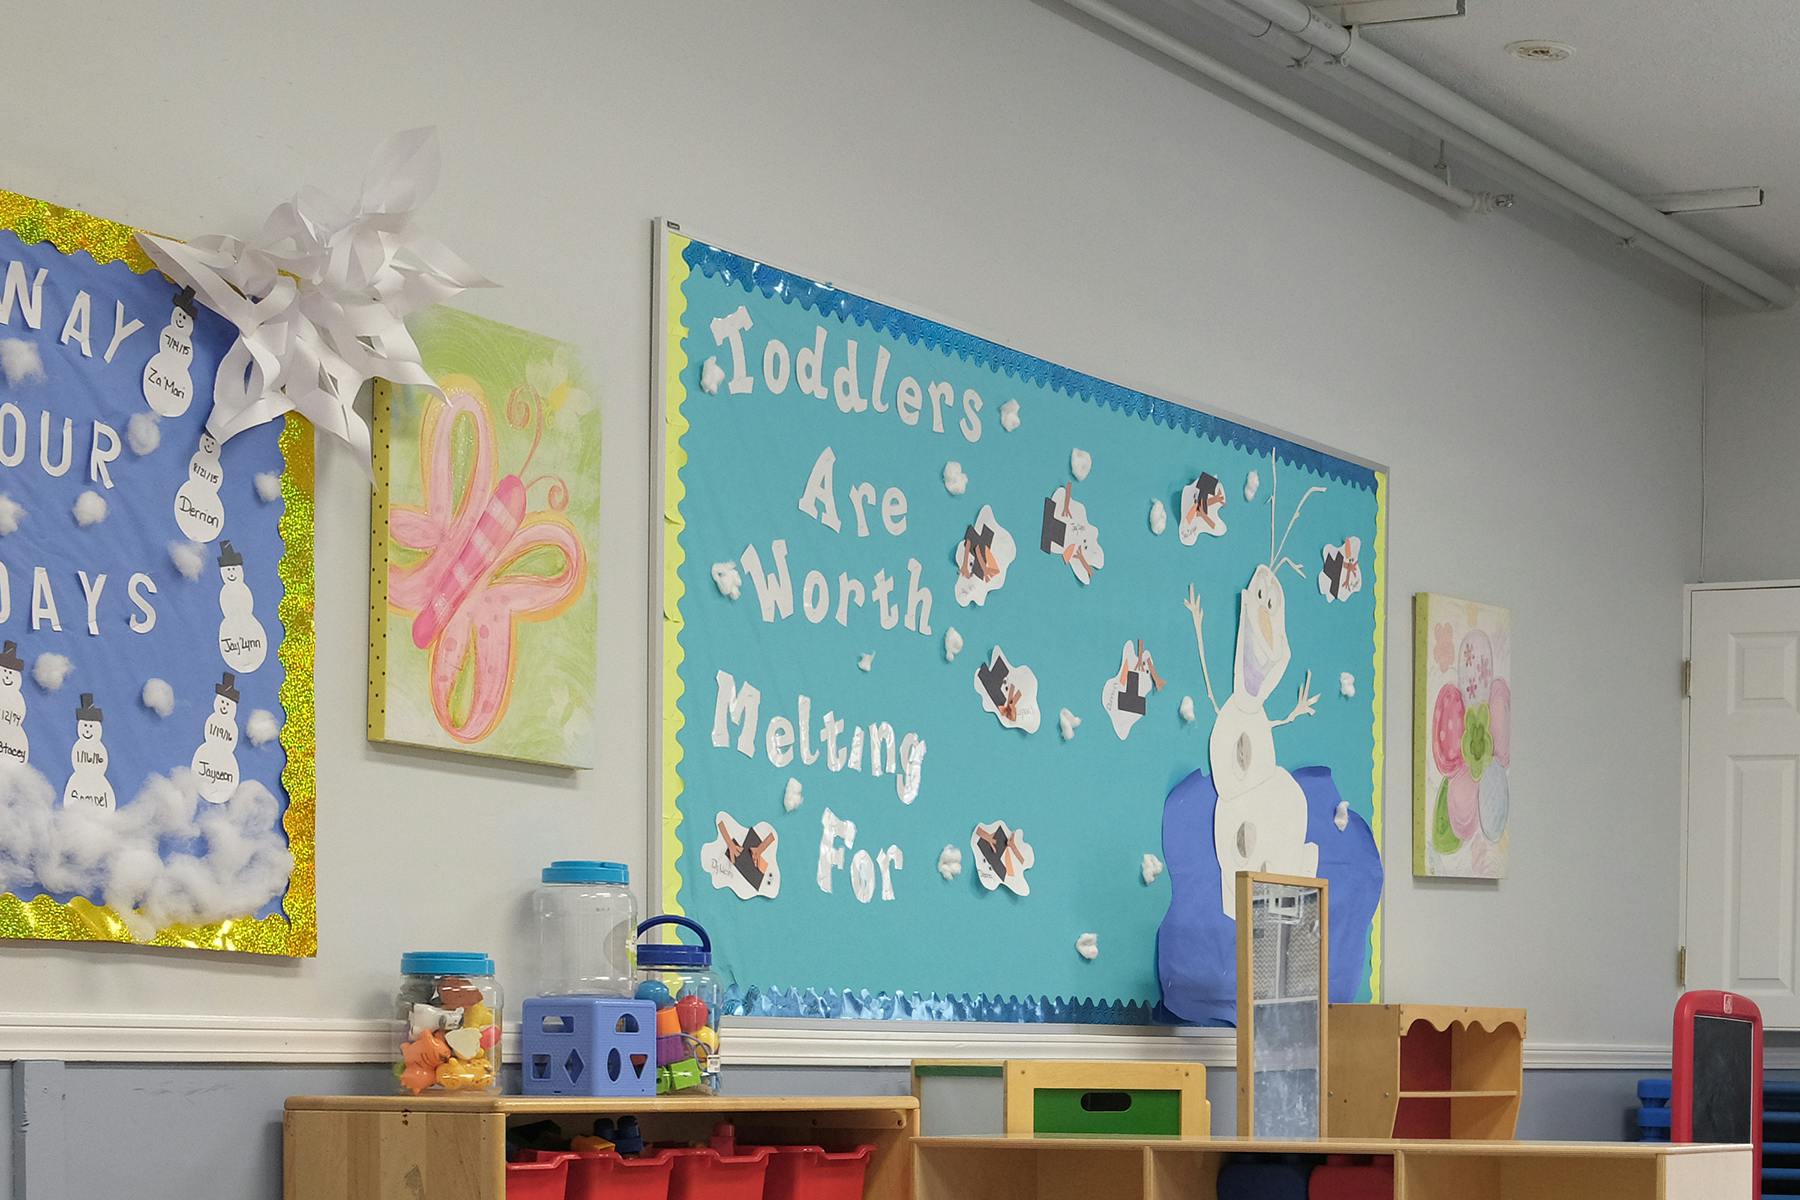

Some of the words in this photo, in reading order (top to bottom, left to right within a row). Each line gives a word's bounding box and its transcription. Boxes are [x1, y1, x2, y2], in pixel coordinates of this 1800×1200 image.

[711, 305, 984, 443] Toddlers
[0, 402, 122, 490] OUR
[798, 446, 908, 537] Are
[740, 539, 933, 636] Worth
[711, 670, 927, 805] Melting
[816, 807, 904, 904] For
